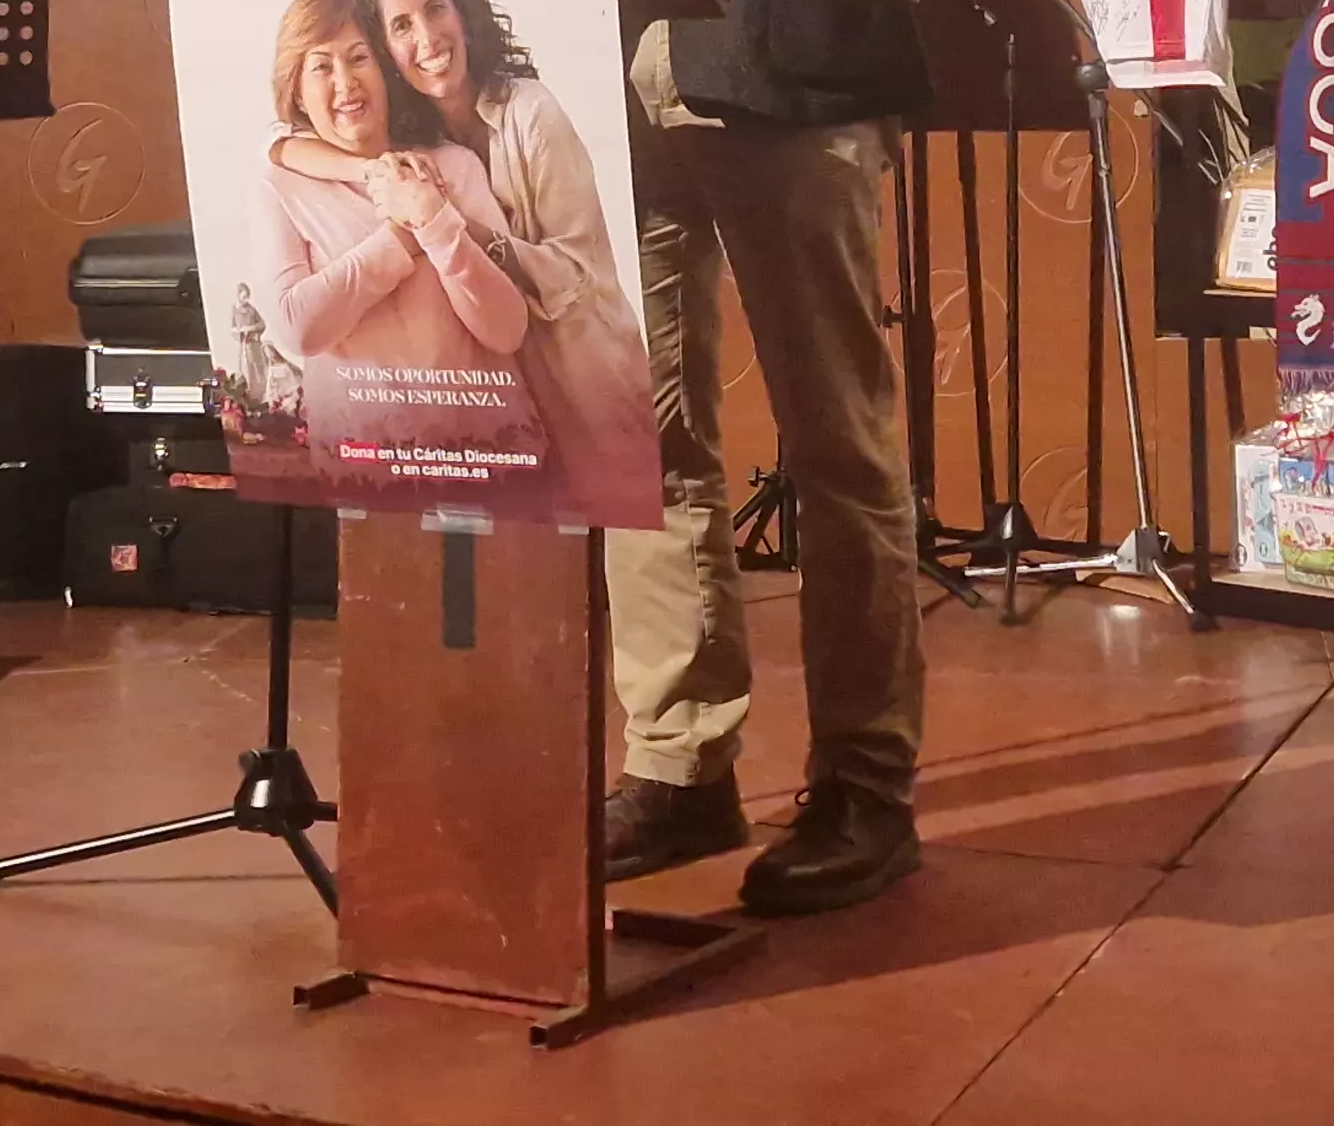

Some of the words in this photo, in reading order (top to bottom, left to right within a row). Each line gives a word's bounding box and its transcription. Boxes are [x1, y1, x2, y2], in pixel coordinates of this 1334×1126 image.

[335, 365, 393, 382] SOMOS
[395, 368, 517, 387] OPORTUNIDAD.
[348, 388, 405, 403] SOMOS
[406, 389, 507, 407] ESPERANZA.
[339, 444, 376, 460] Dona
[377, 449, 395, 460] en
[396, 447, 412, 461] tu
[413, 446, 463, 463] Cáritas
[464, 449, 538, 466] Diocesana
[391, 464, 401, 475] o
[403, 464, 420, 475] en
[422, 464, 489, 479] caritas.es
